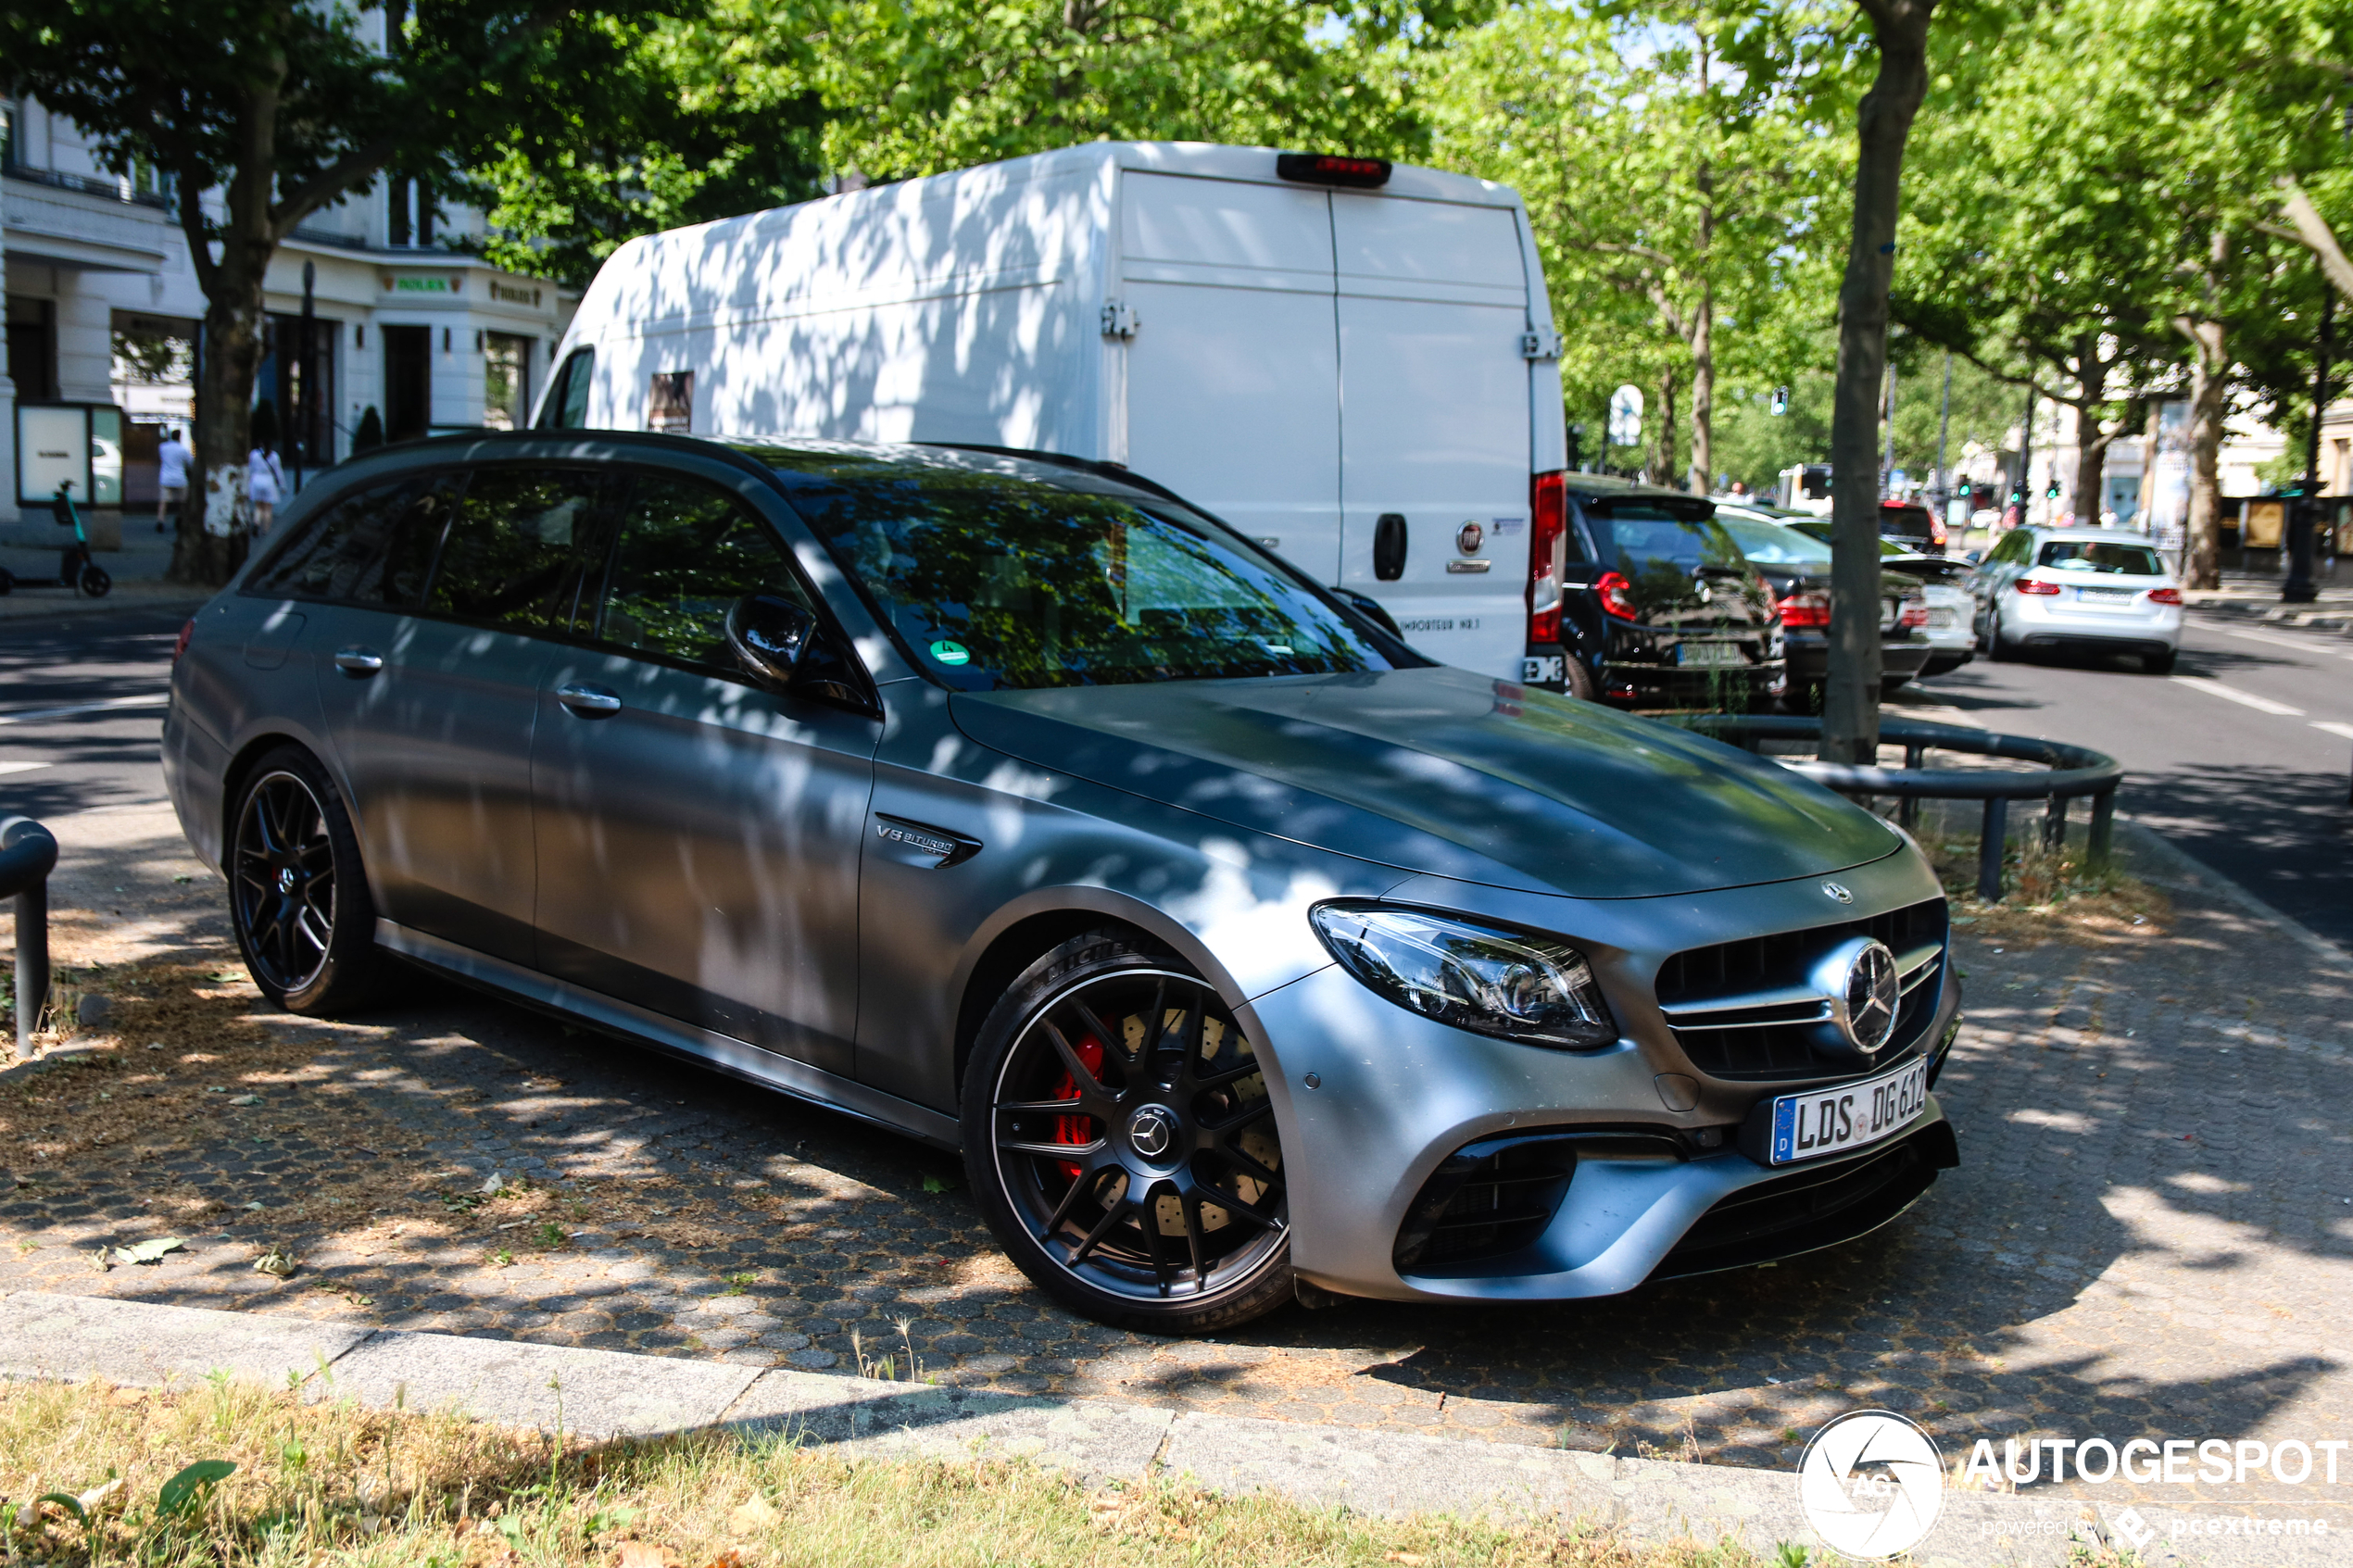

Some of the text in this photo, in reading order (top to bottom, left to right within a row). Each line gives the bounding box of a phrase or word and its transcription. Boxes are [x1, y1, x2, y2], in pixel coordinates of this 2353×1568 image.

[1400, 619, 1454, 632] IMPORTEUR
[876, 825, 953, 851] V8 BITURBO
[1048, 937, 1154, 981] MICHEL
[1797, 1063, 1925, 1150] LDS DG 612
[1779, 1137, 1788, 1152] D
